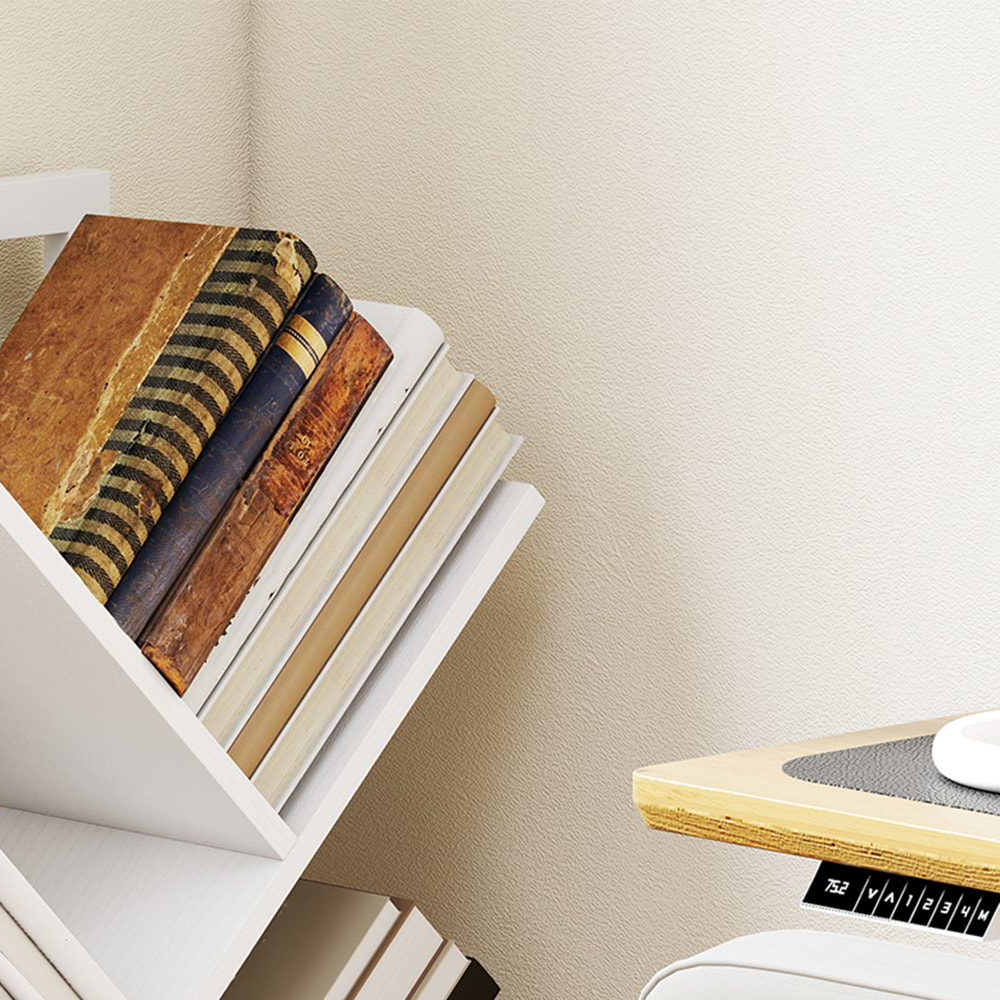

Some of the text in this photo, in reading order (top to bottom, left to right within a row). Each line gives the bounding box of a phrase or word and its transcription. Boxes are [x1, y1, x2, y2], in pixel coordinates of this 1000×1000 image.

[905, 894, 914, 907] 1
[922, 897, 934, 911] 2
[940, 901, 953, 914] 3
[961, 905, 972, 918] 4
